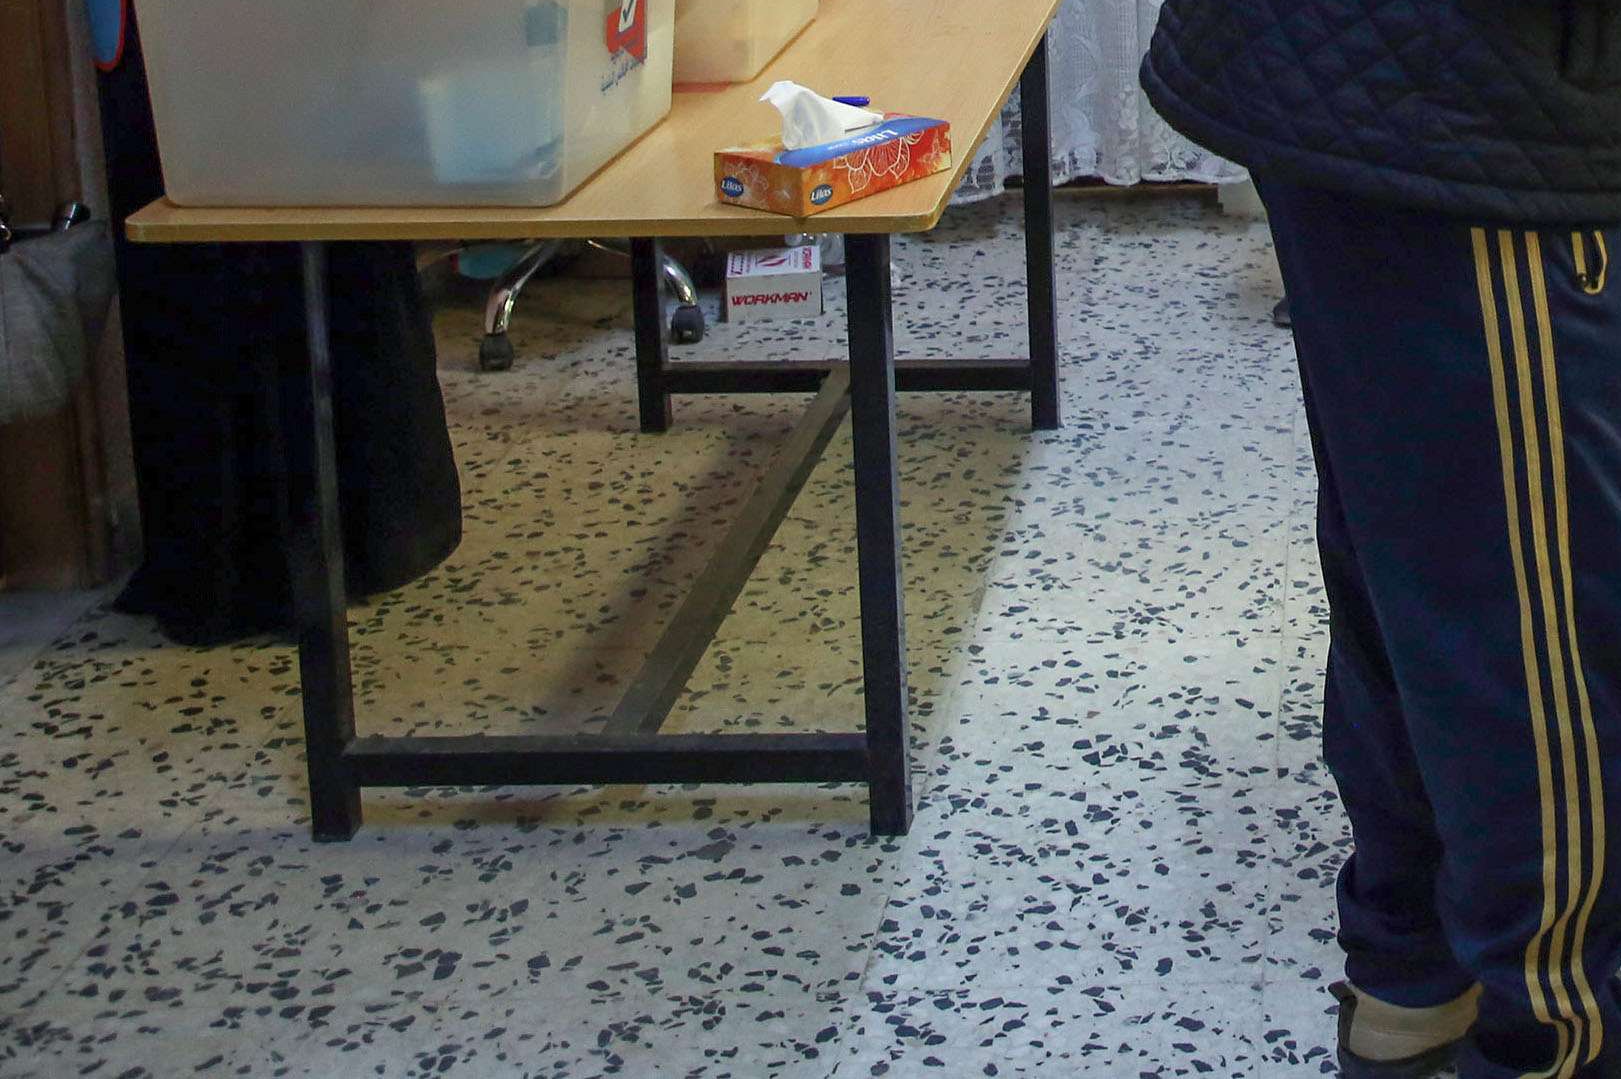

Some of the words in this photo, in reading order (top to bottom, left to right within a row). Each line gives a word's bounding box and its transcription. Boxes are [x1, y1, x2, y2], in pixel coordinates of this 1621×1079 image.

[852, 129, 898, 145] Lilas
[720, 177, 744, 193] Lilas
[811, 187, 833, 202] Lilas
[731, 291, 808, 306] WORKMAN
